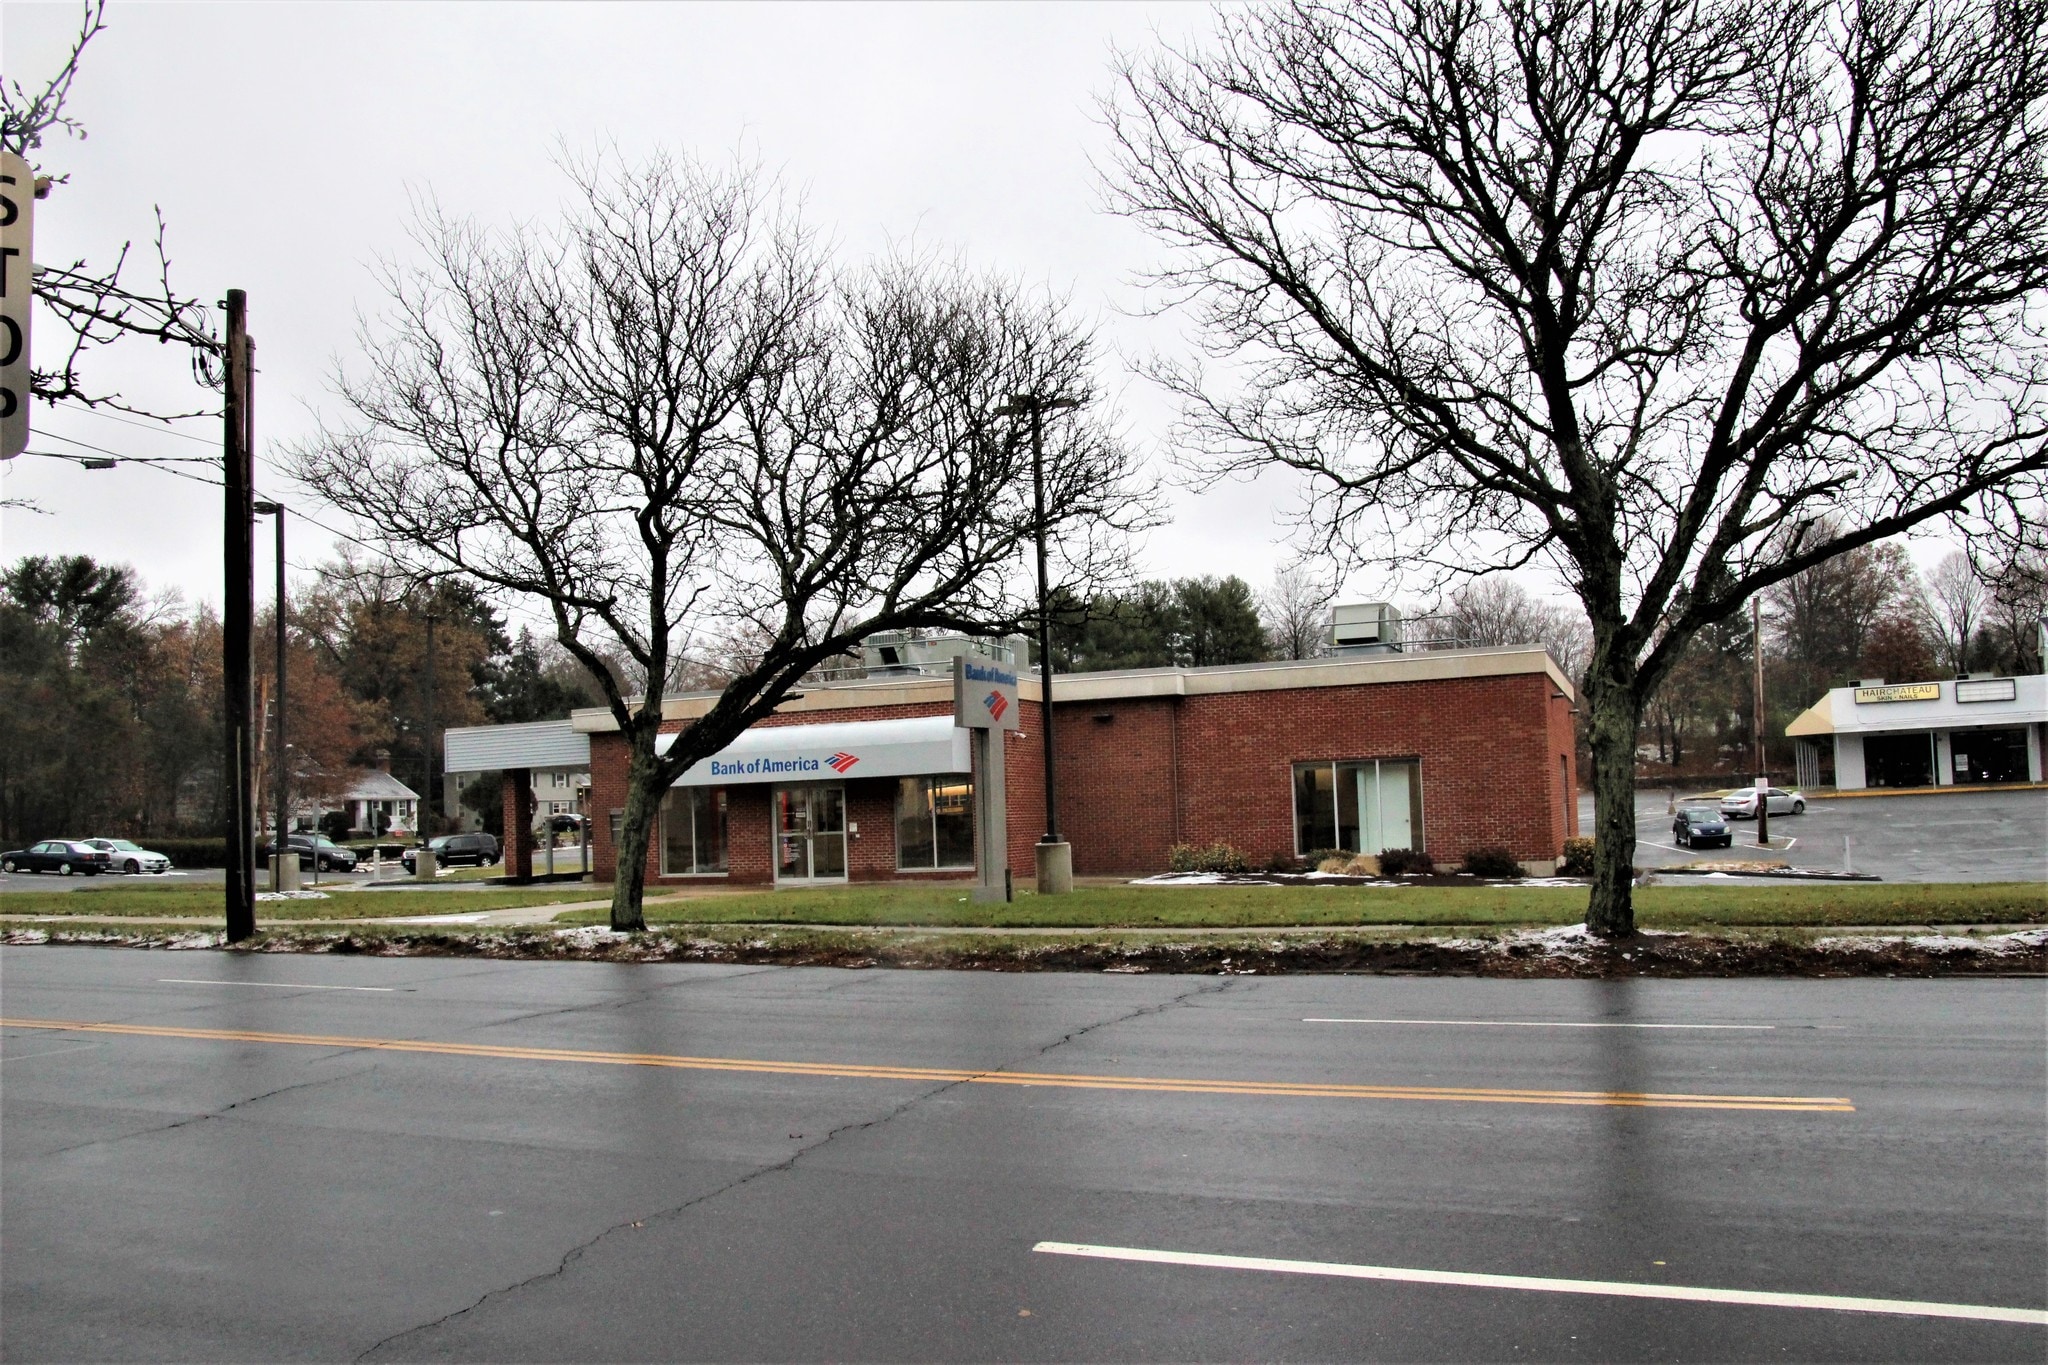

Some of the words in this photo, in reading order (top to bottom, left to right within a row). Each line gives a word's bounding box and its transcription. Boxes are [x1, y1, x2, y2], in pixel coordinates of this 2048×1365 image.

[965, 664, 985, 681] Bank
[986, 667, 995, 683] of
[995, 668, 1017, 686] America
[711, 760, 745, 776] Bank
[747, 758, 761, 774] of
[762, 756, 819, 773] America
